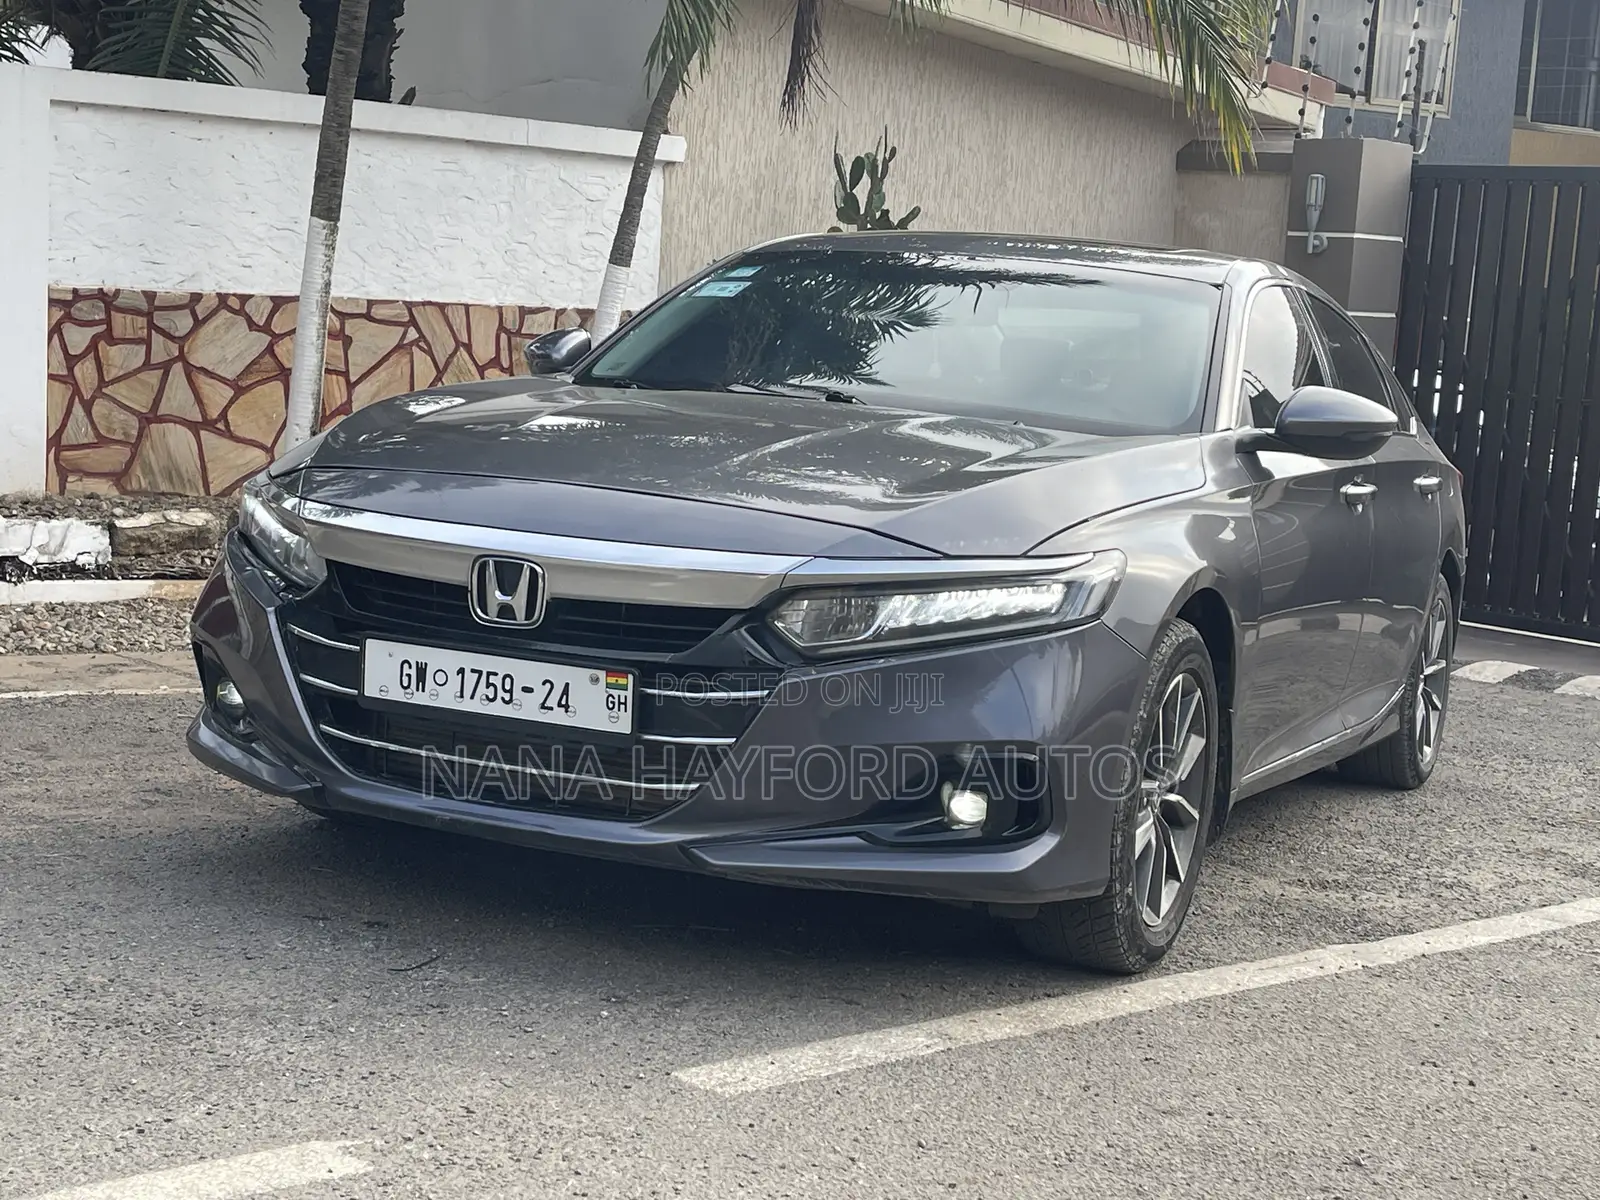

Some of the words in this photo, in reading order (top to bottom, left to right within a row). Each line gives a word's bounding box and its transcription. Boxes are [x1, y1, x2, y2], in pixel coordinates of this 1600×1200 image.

[399, 659, 428, 693] GW
[456, 666, 571, 714] 1759-24
[606, 693, 628, 713] GH
